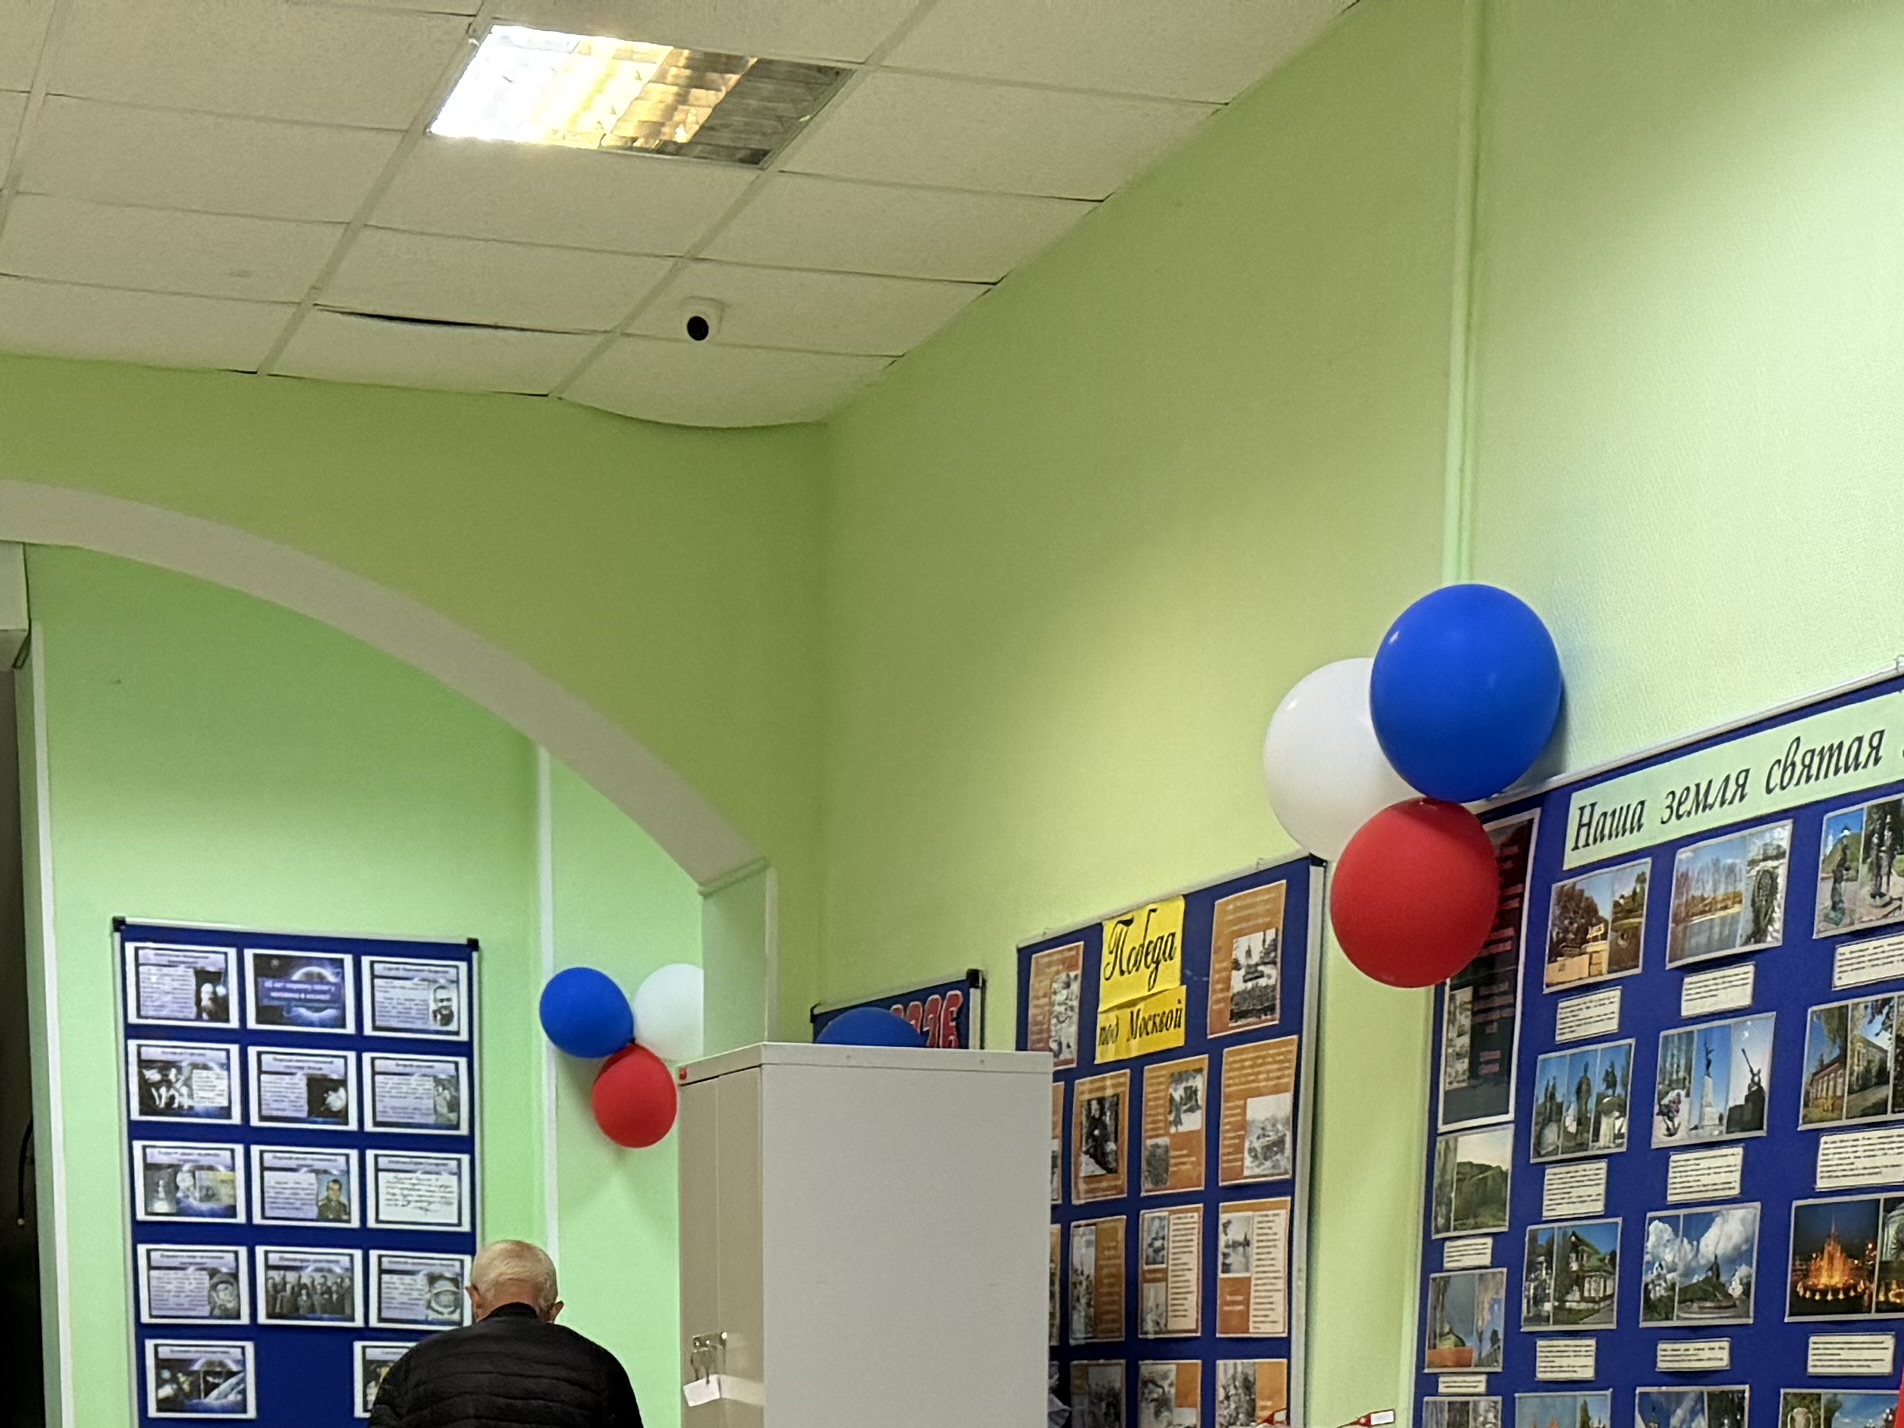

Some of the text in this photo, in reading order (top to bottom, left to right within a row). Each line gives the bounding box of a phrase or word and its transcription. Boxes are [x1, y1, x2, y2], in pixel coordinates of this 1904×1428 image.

[1572, 796, 1647, 853] Наша
[1659, 763, 1751, 824] земля
[1763, 724, 1884, 792] святая
[1104, 908, 1176, 992] Победа
[1099, 999, 1183, 1047] под Москвой
